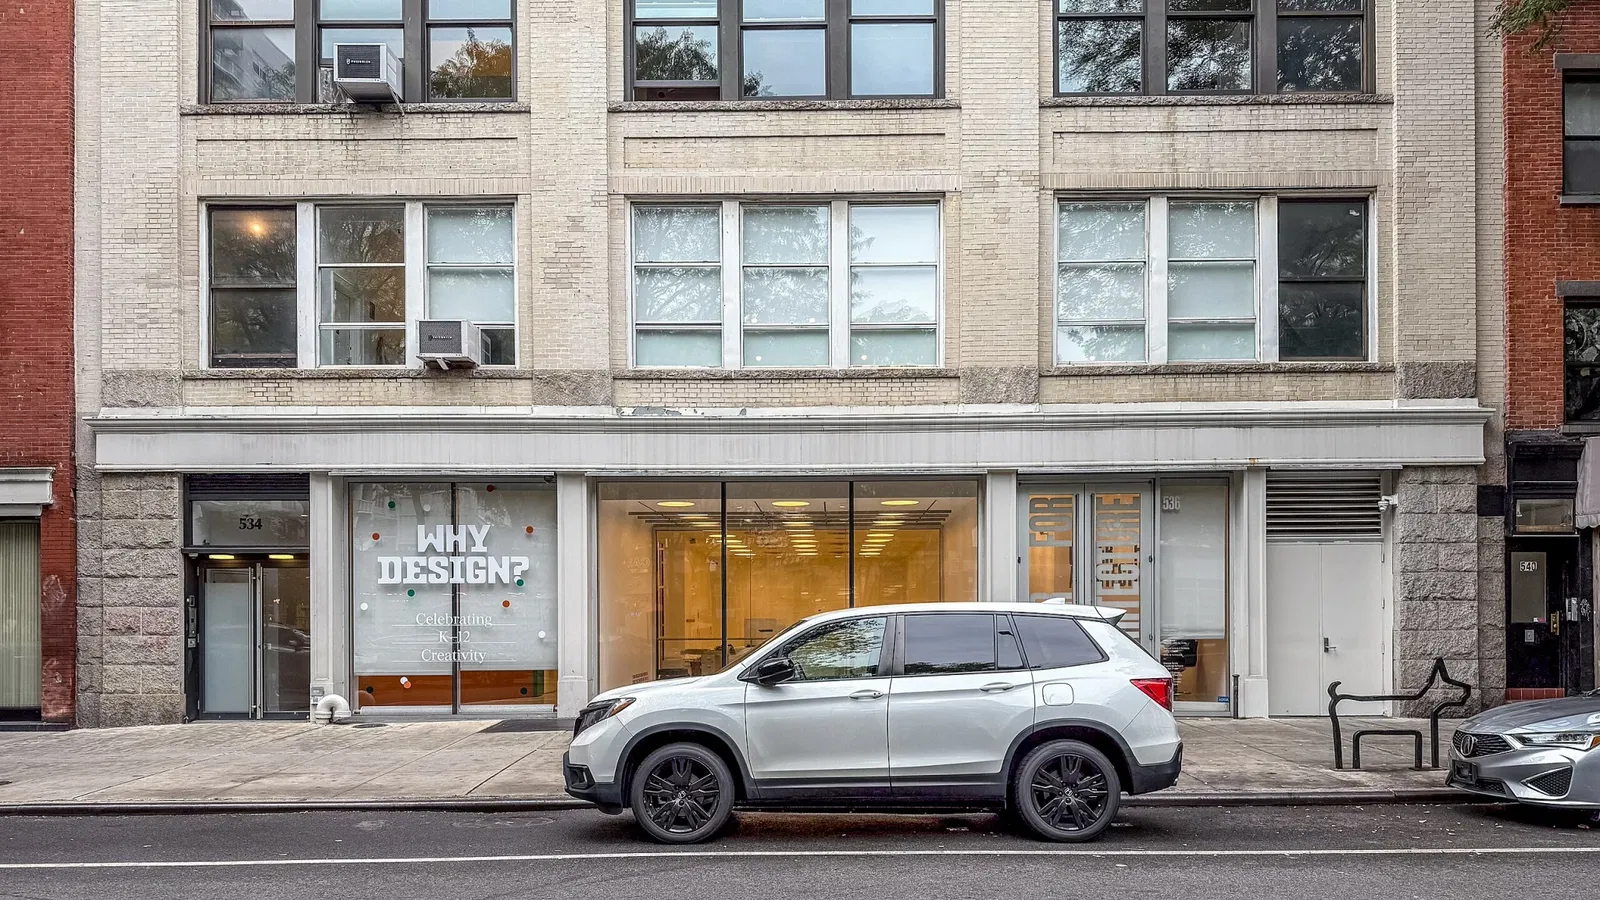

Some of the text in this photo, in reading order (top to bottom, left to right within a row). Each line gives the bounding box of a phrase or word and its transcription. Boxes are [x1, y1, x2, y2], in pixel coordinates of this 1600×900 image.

[1162, 495, 1181, 511] 536
[239, 517, 263, 530] 534
[1029, 497, 1073, 547] FOR
[417, 524, 491, 553] WHY
[377, 556, 530, 584] DESIGN?
[1096, 496, 1140, 640] TECTURE
[1519, 561, 1538, 572] 540
[415, 612, 493, 627] Celebrating
[421, 649, 487, 664] Creativity
